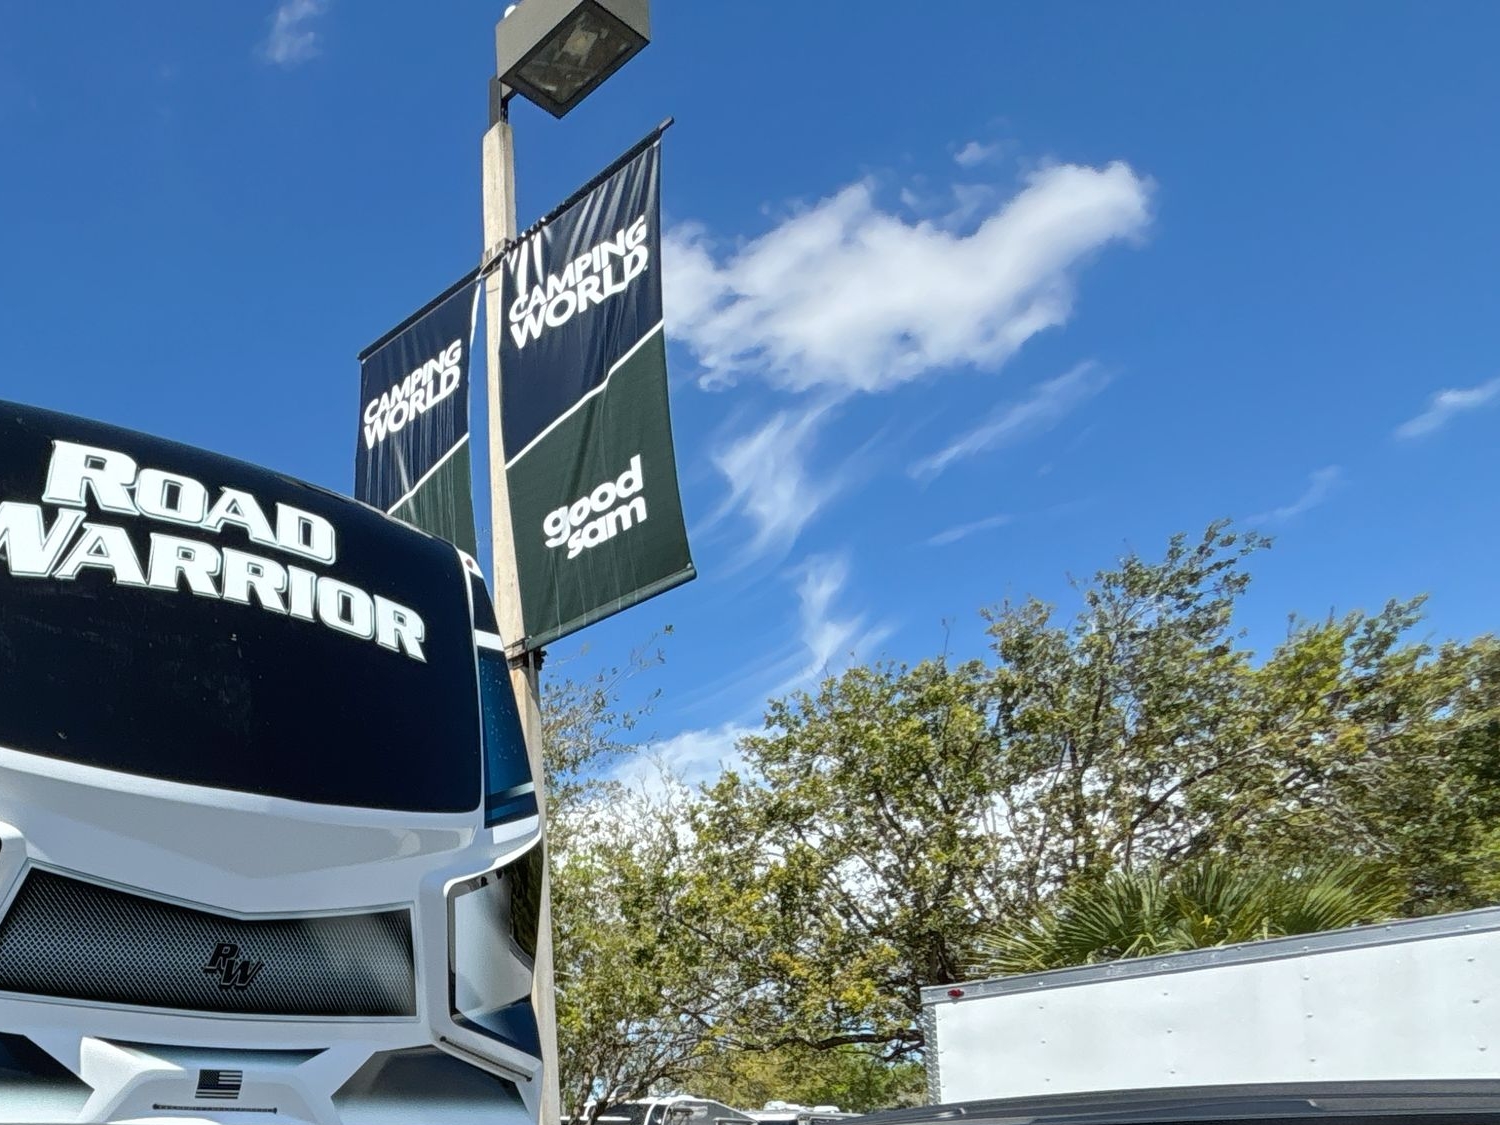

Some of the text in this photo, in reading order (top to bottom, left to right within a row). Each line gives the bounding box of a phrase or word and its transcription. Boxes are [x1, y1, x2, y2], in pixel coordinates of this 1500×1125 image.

[509, 214, 647, 323] CAMPING
[510, 245, 649, 350] WORLD
[363, 338, 462, 425] CAMPING
[363, 365, 461, 450] WORLD
[41, 439, 337, 565] ROAD
[543, 453, 644, 549] good
[567, 496, 647, 559] sam
